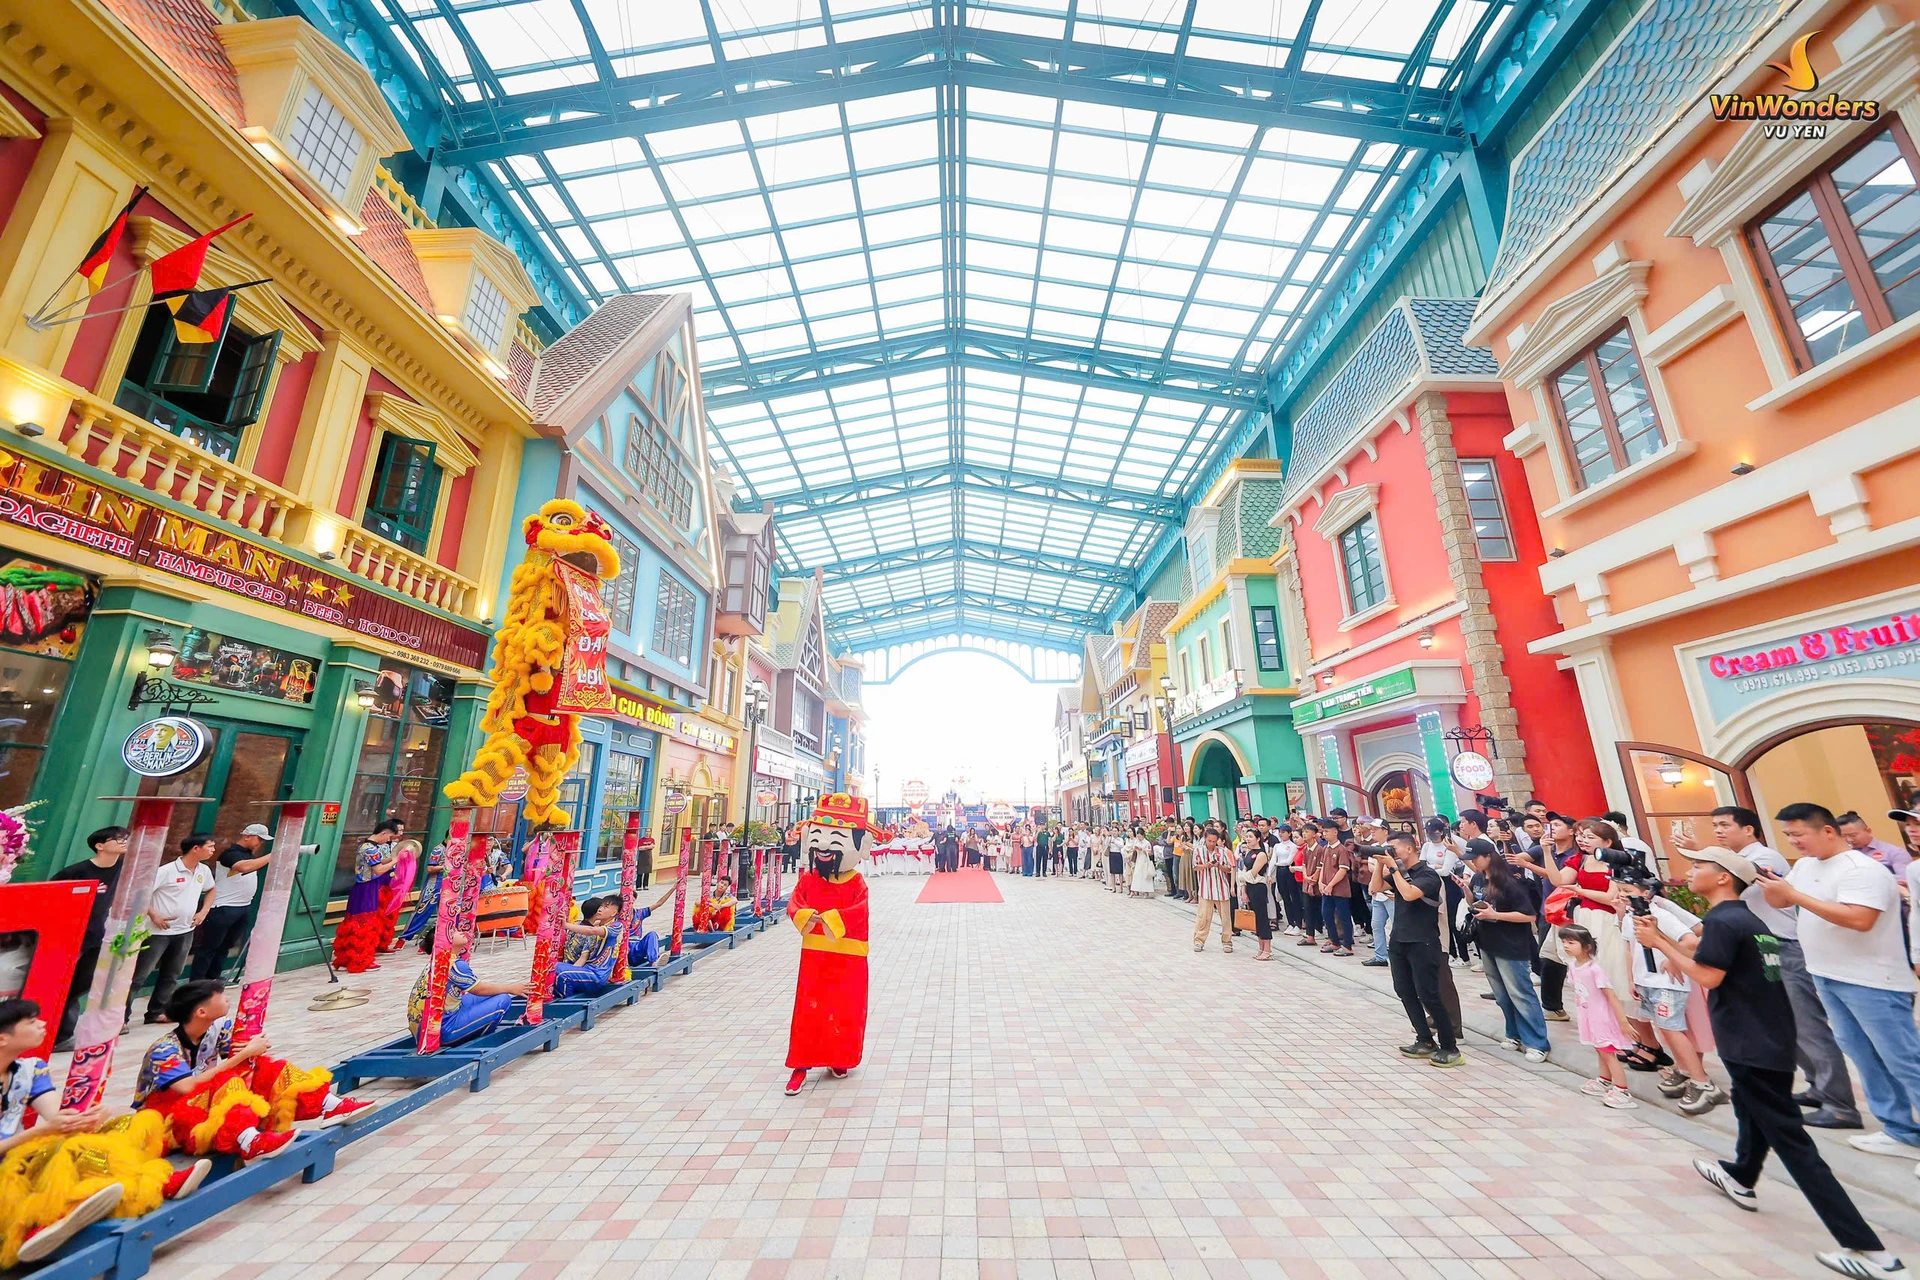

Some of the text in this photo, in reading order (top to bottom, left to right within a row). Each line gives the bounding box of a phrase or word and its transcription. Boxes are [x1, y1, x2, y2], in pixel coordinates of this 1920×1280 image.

[152, 514, 285, 582] MAN
[155, 550, 286, 605] HAMBURGER
[302, 599, 344, 625] BEER
[358, 618, 421, 648] HOTDOG
[1709, 645, 1798, 678] Cream
[1800, 633, 1827, 660] &
[1743, 667, 1819, 691] 0979.674.999
[619, 697, 645, 720] CUA
[647, 704, 676, 730] ĐỒNG
[143, 750, 172, 762] BERLIN
[145, 759, 166, 770] MAN
[1461, 765, 1485, 773] FOOD
